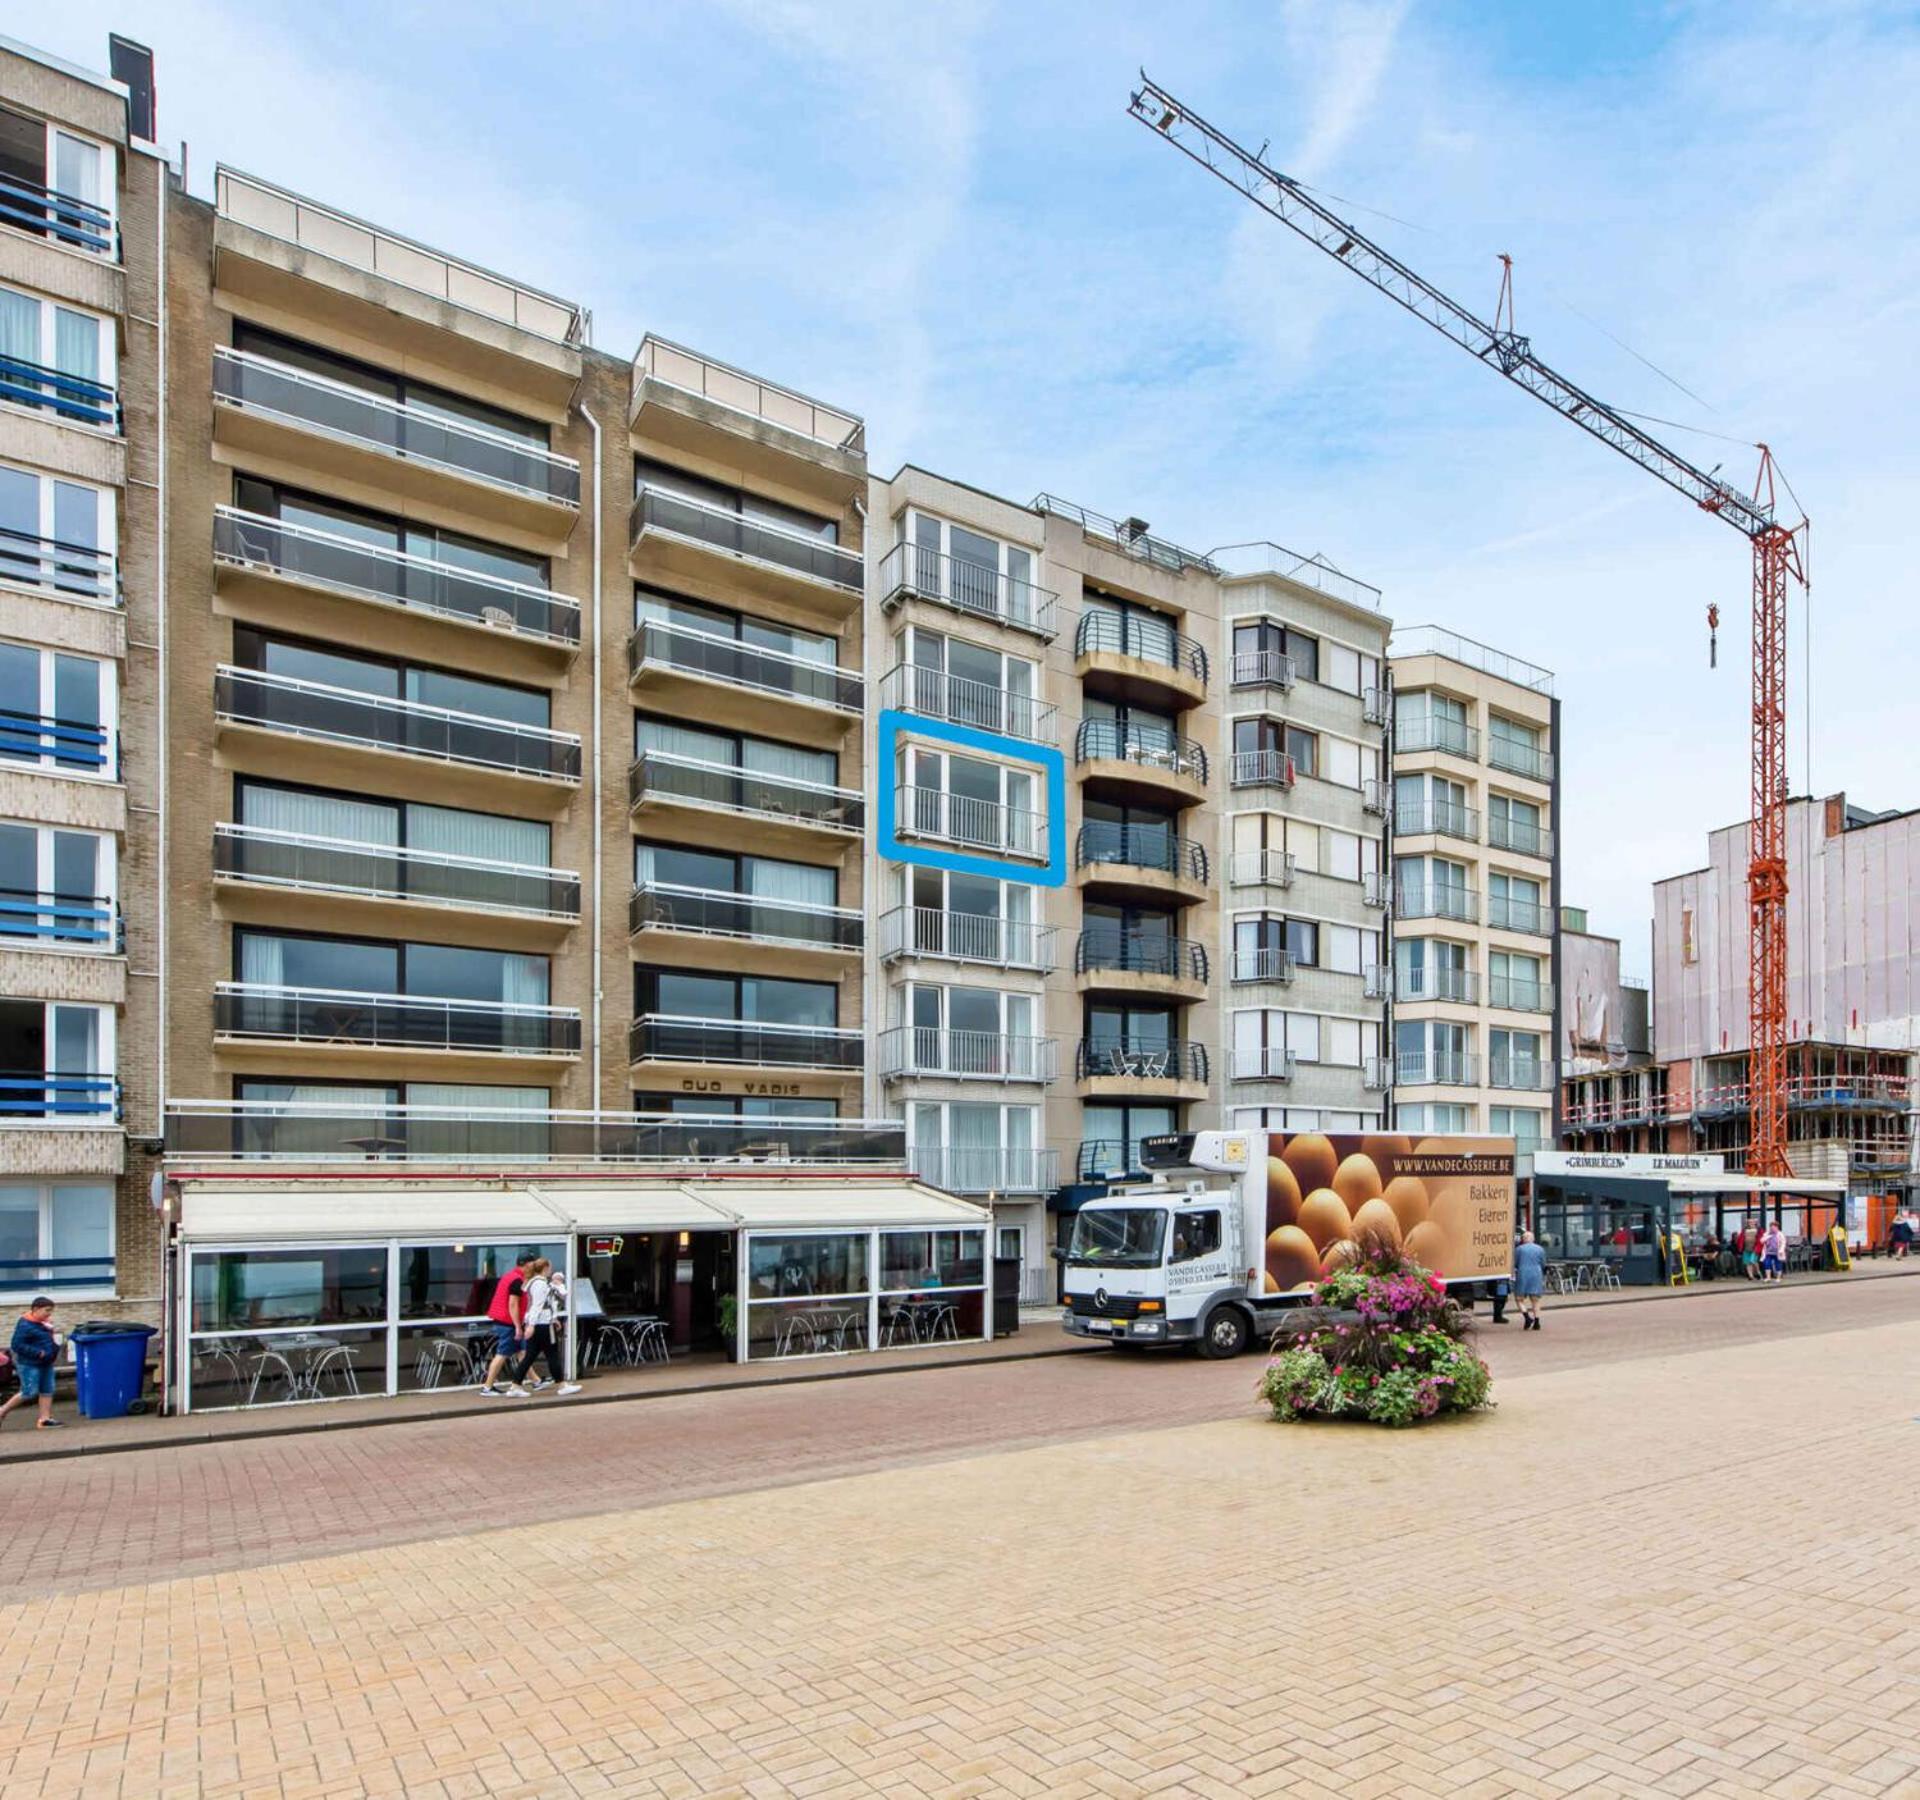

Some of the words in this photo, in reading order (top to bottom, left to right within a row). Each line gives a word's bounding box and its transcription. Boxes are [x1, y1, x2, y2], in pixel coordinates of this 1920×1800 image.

[744, 1083, 800, 1095] VADIS
[1393, 1158, 1510, 1172] WWW.VANDECASSERIE.BE
[1470, 1184, 1509, 1203] Bakkerij
[1478, 1207, 1508, 1223] Eieren
[1472, 1230, 1508, 1246] Horeca
[1477, 1249, 1508, 1268] Zuivel
